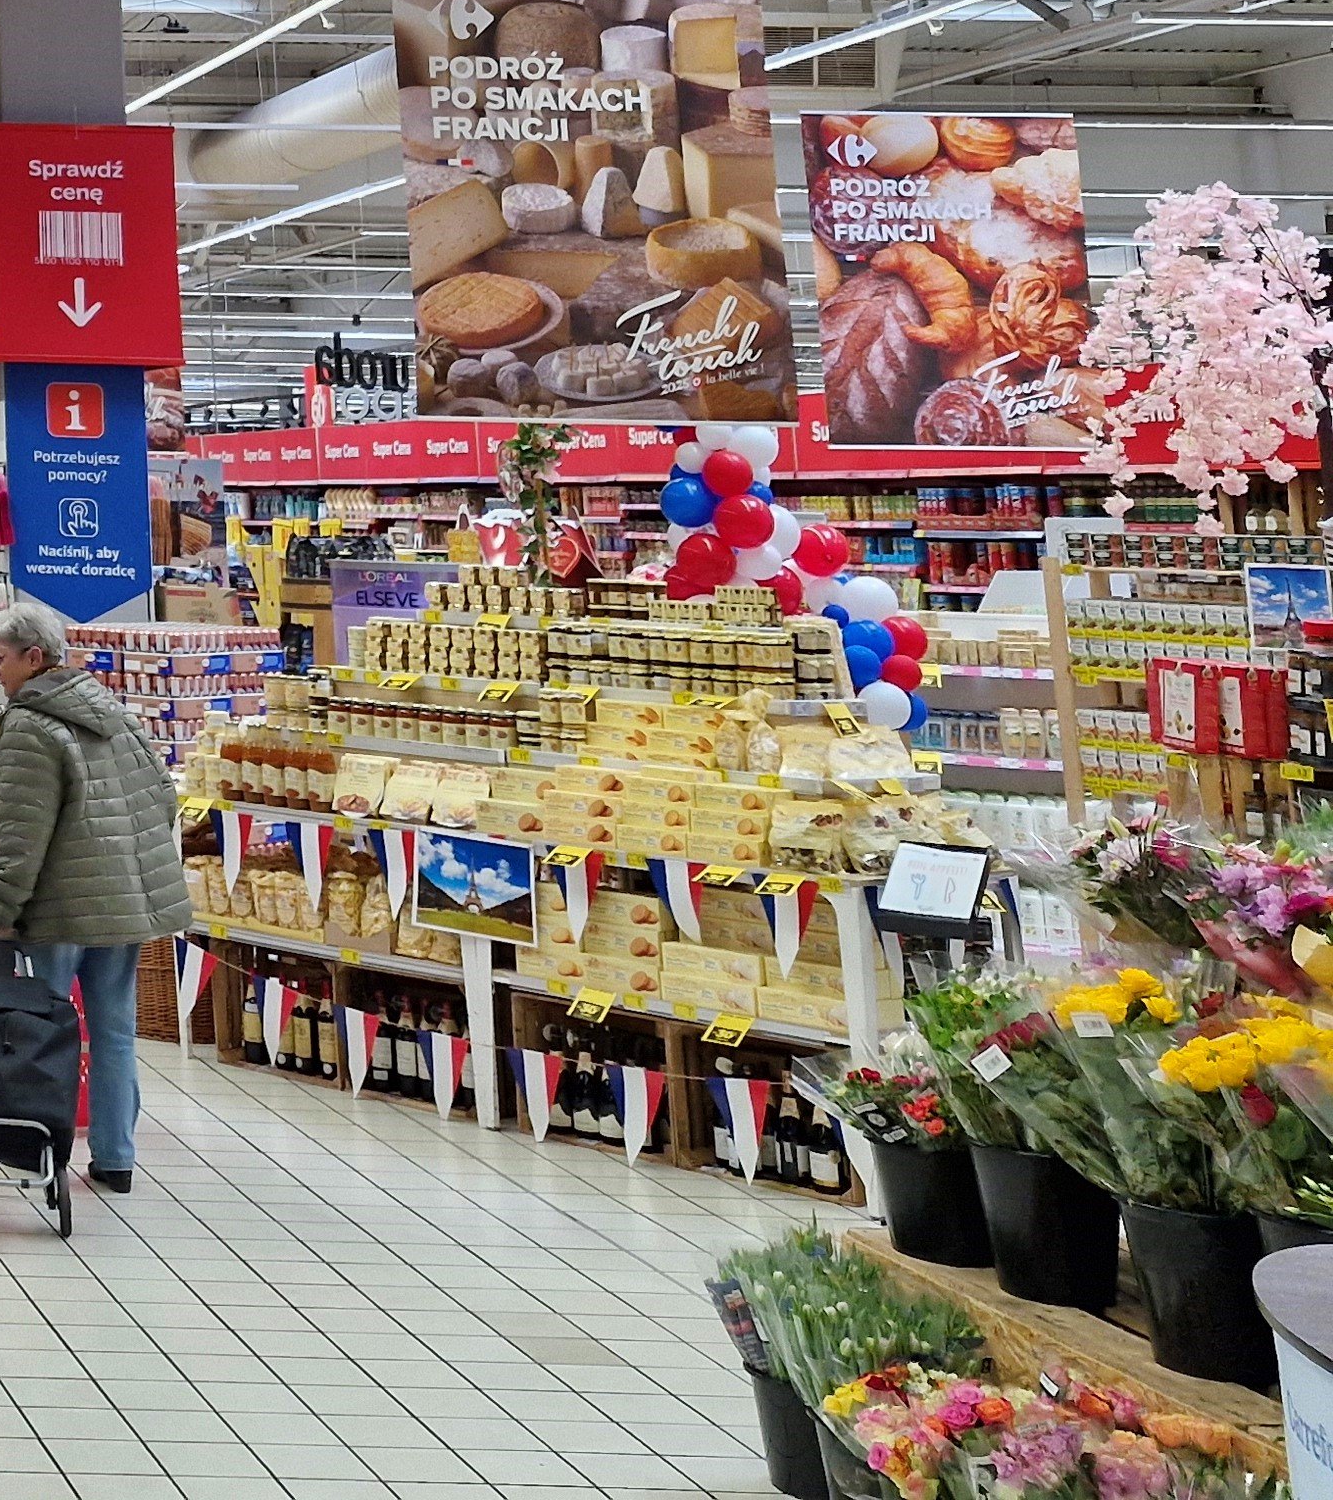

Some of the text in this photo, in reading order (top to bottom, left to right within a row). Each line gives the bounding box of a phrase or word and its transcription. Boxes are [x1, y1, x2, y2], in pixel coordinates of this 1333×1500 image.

[428, 51, 564, 81] PODRÓŻ
[431, 86, 649, 112] PO SMAKACH
[433, 117, 569, 142] FRANCJI
[28, 159, 124, 181] Sprawdź
[50, 186, 104, 205] cenę
[830, 175, 931, 198] PODRÓŻ
[833, 201, 991, 220] PO SMAKACH
[834, 223, 936, 242] FRANCJI
[616, 290, 740, 363] French
[649, 321, 764, 381] touch
[660, 379, 689, 397] 2025
[996, 373, 1081, 419] touch
[581, 431, 606, 449] Cena
[628, 427, 656, 448] Super
[393, 440, 411, 456] Cena
[427, 439, 448, 458] Super
[449, 438, 469, 454] Cena
[34, 450, 120, 466] Potrzebujesz
[48, 470, 107, 484] pomocy?
[39, 545, 119, 562] Naciśnij, aby
[26, 562, 135, 580] wezwać doradcę
[356, 590, 419, 608] ELSEVE
